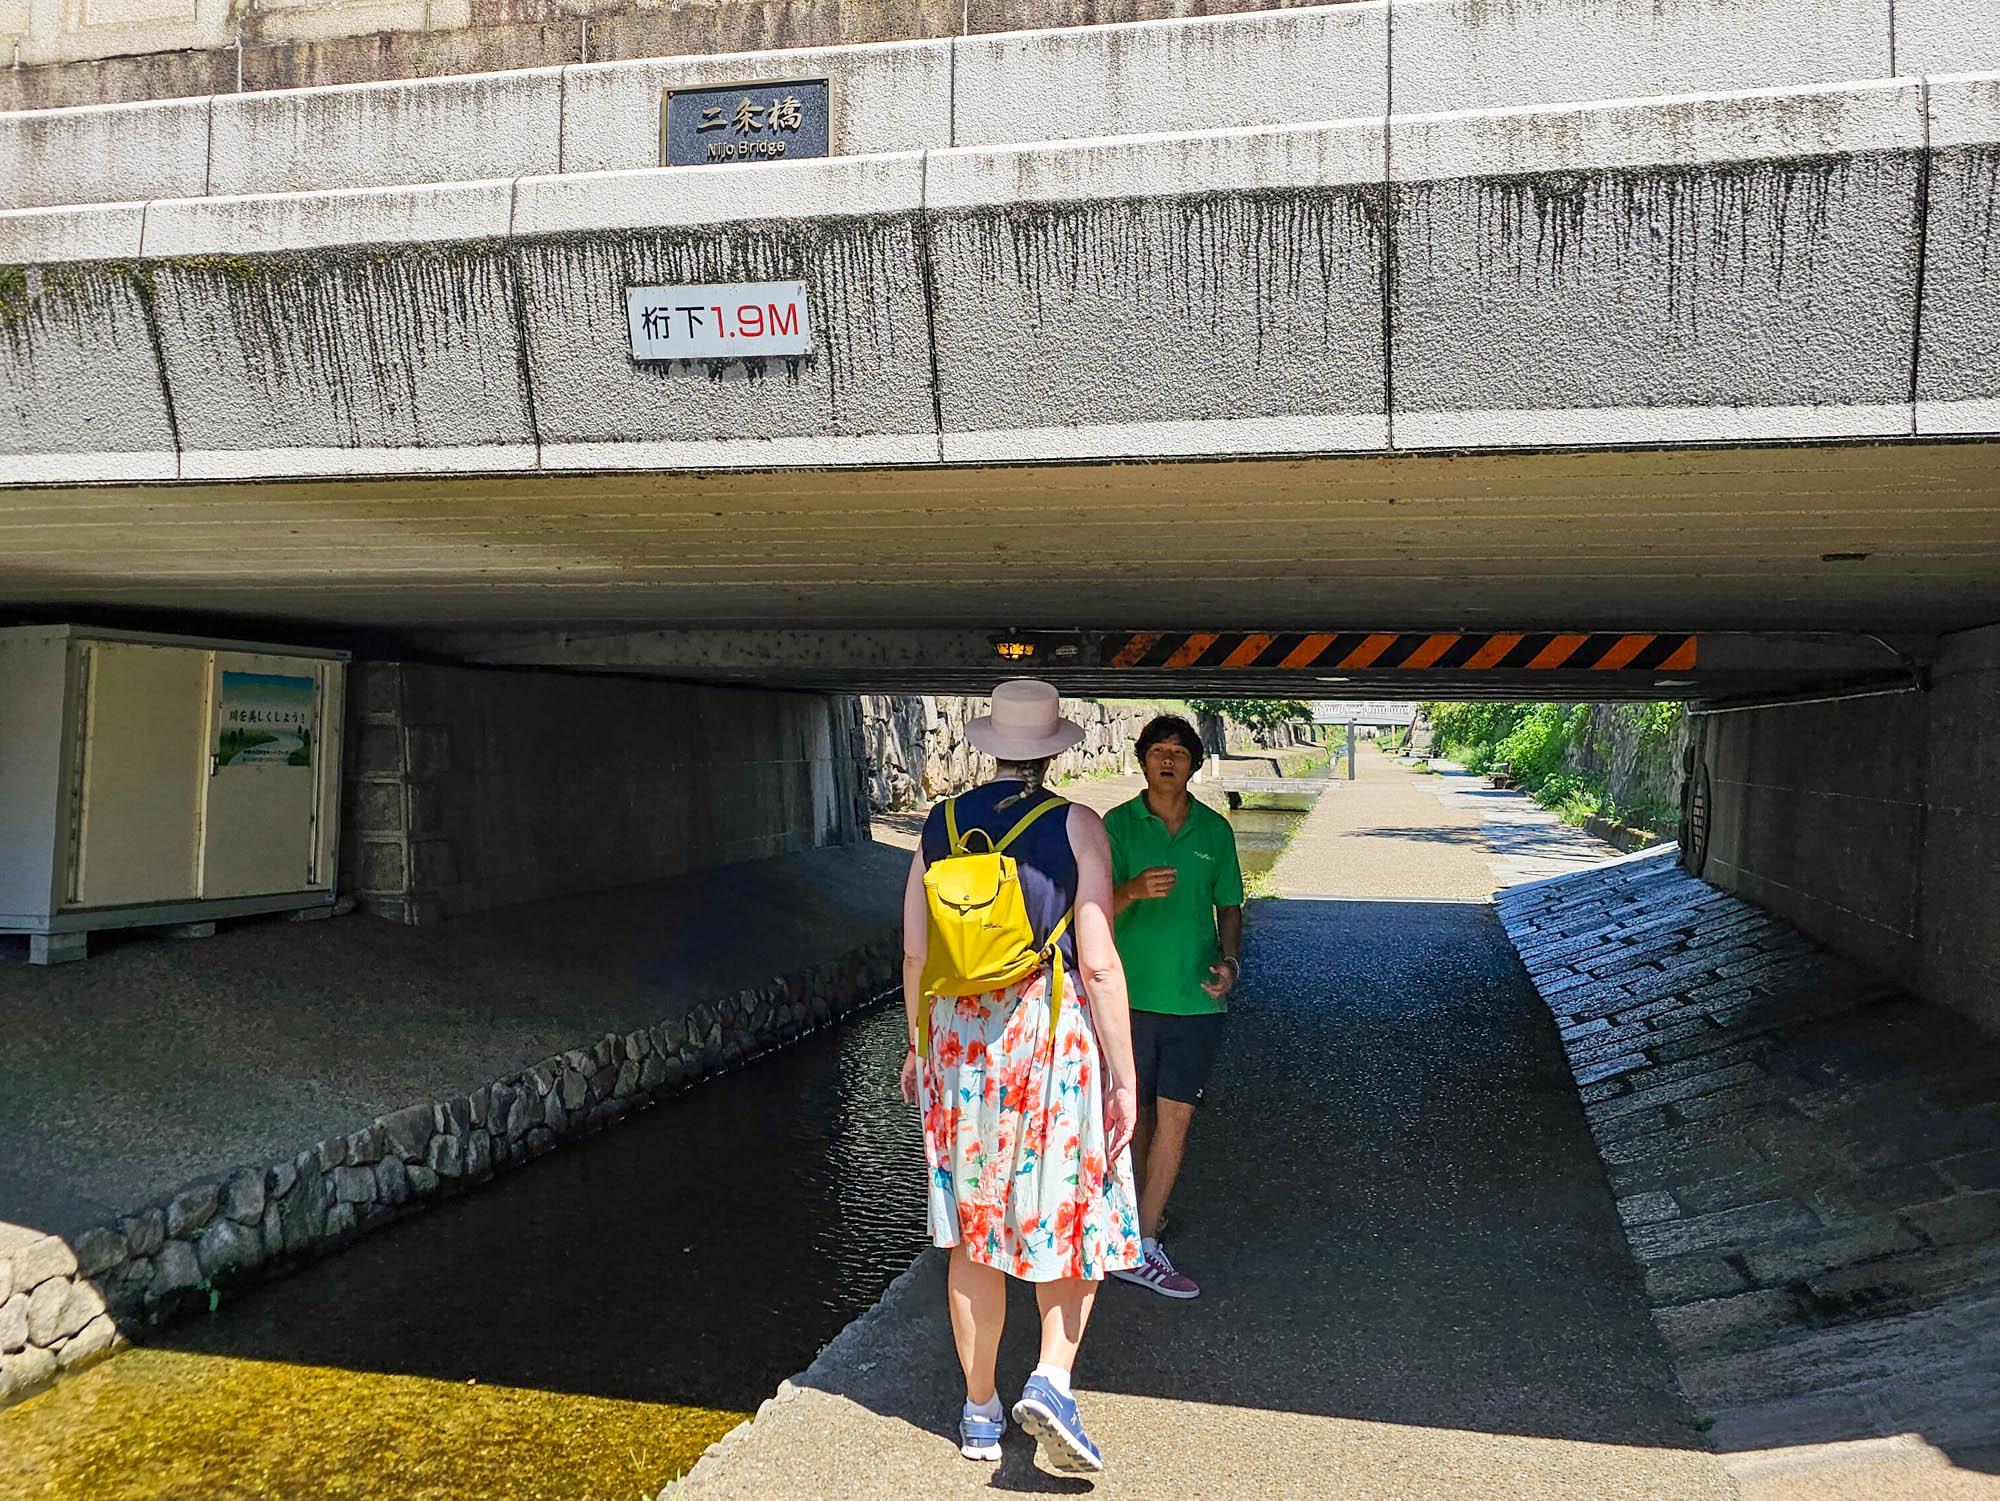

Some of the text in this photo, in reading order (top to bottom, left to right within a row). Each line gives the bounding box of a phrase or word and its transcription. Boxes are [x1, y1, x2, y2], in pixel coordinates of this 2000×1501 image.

[697, 96, 802, 133] 二条橋
[739, 140, 786, 157] Bridge
[641, 303, 799, 340] 桁下1.9M
